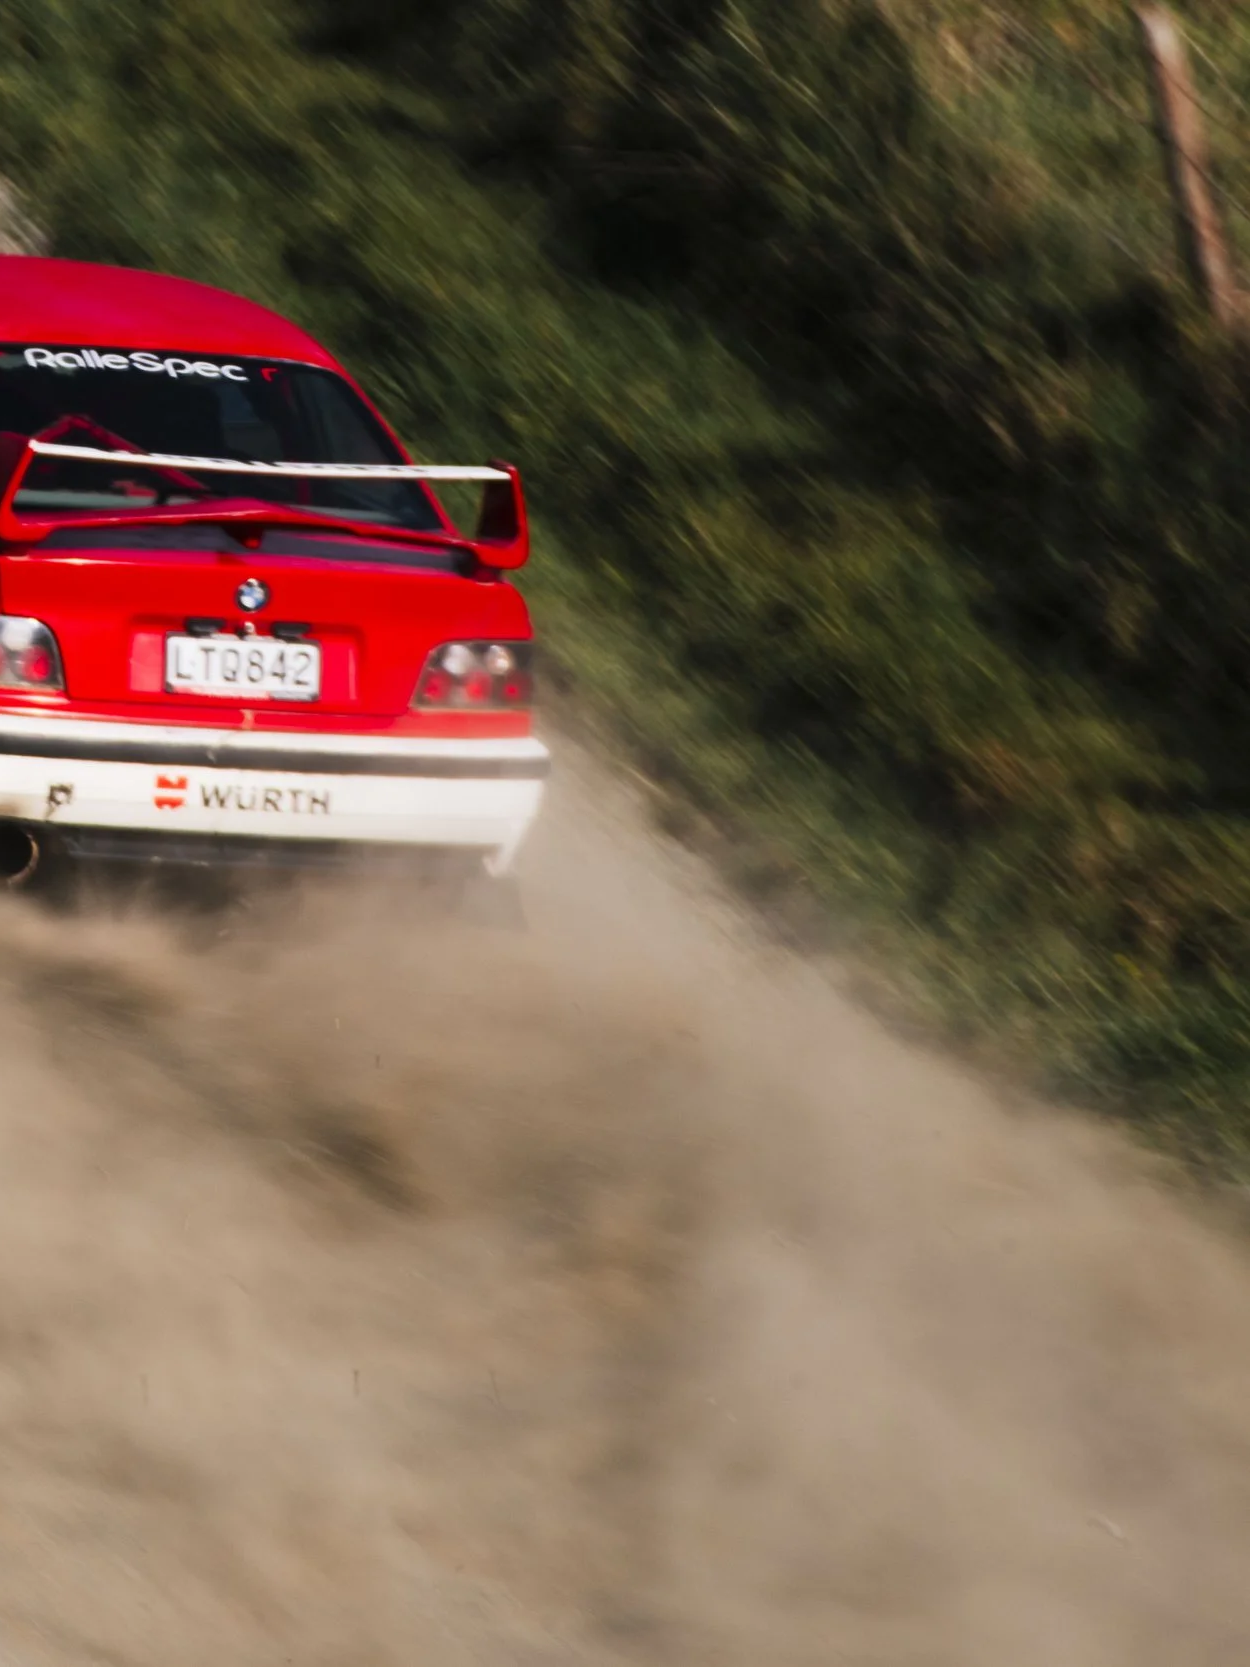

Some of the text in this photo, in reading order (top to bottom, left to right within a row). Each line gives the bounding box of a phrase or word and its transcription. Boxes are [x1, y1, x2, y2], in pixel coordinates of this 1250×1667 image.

[24, 347, 249, 382] RalleSpec
[173, 645, 313, 687] LTQ842
[200, 783, 331, 816] WÜRTH
